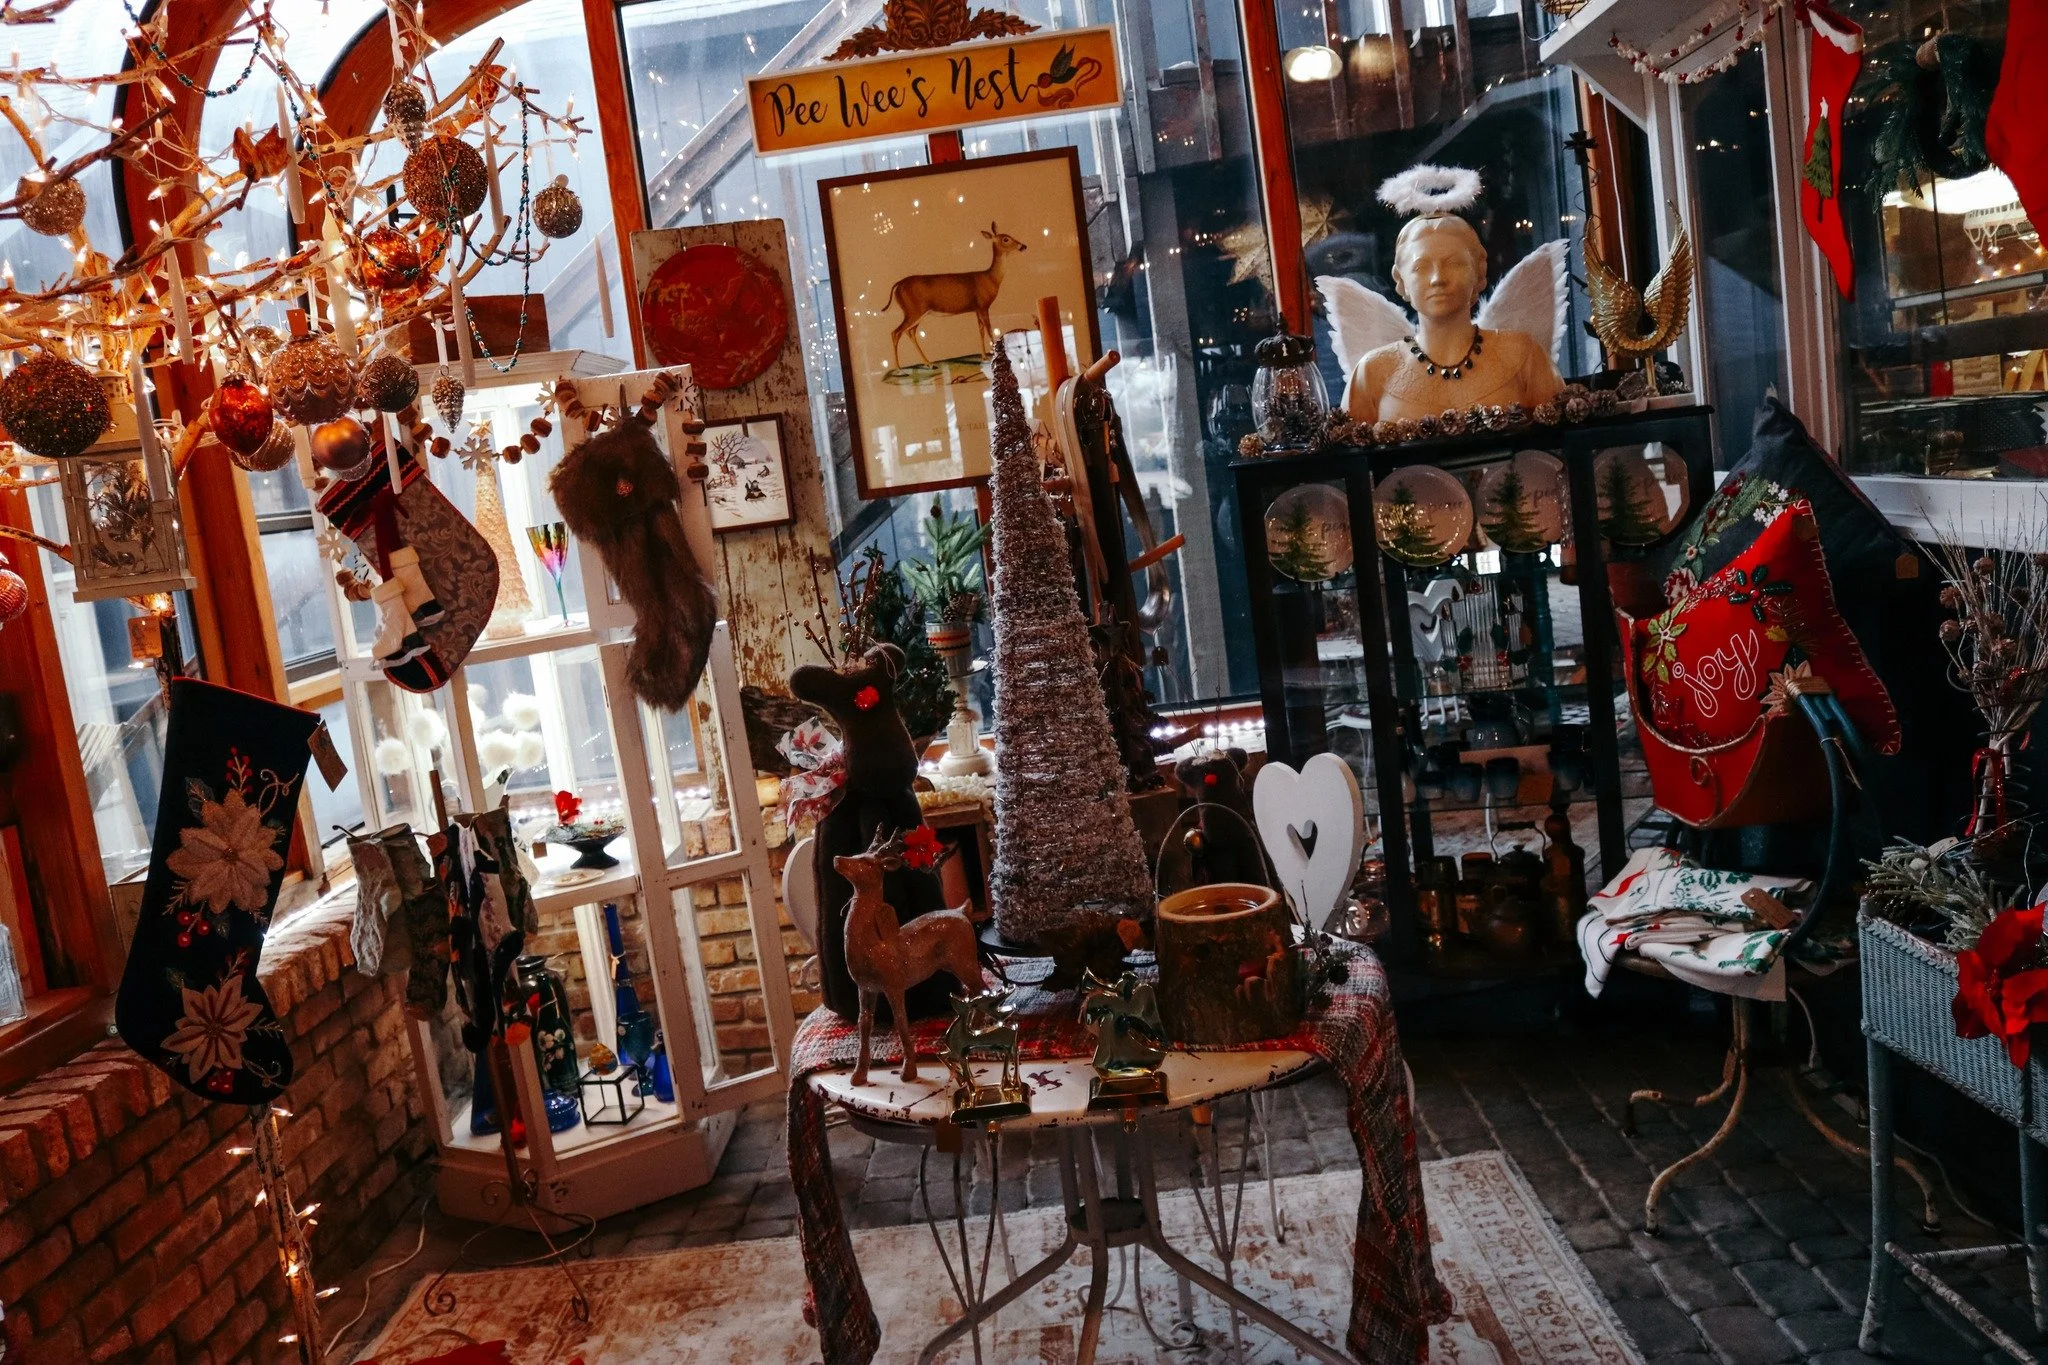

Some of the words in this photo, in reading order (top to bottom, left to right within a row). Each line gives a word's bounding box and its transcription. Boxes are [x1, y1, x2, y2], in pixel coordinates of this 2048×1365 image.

[764, 83, 829, 137] Pee
[834, 67, 936, 129] Wee's
[948, 47, 1027, 110] Nest
